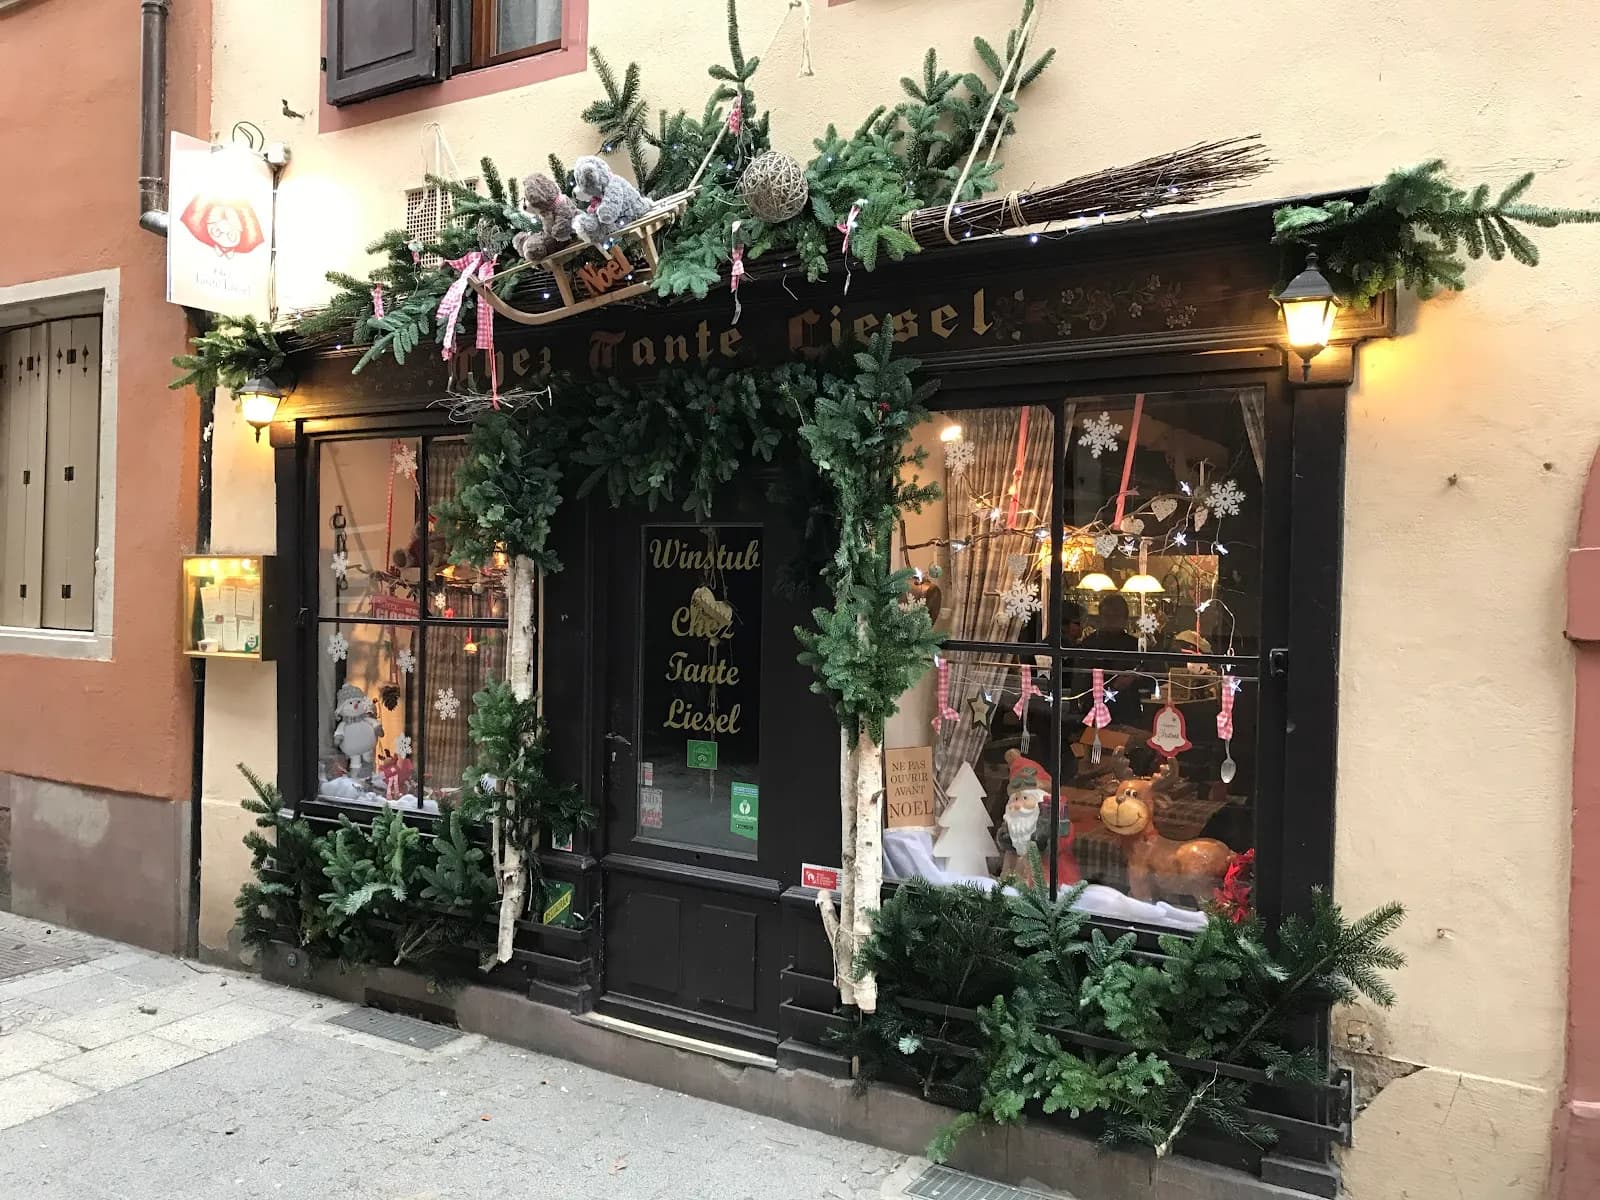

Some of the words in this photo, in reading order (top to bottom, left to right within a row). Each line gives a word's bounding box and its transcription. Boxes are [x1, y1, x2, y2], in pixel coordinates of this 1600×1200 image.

[588, 319, 743, 372] Tante
[787, 287, 994, 360] Liesel
[649, 538, 761, 571] Winstub
[671, 604, 735, 639] Chez
[665, 651, 740, 686] Tante
[663, 698, 741, 734] Liesel
[890, 773, 928, 784] OUVRIR
[891, 761, 906, 772] NE
[908, 760, 926, 771] PAS
[894, 785, 926, 796] AVANT
[889, 800, 934, 819] NOEL
